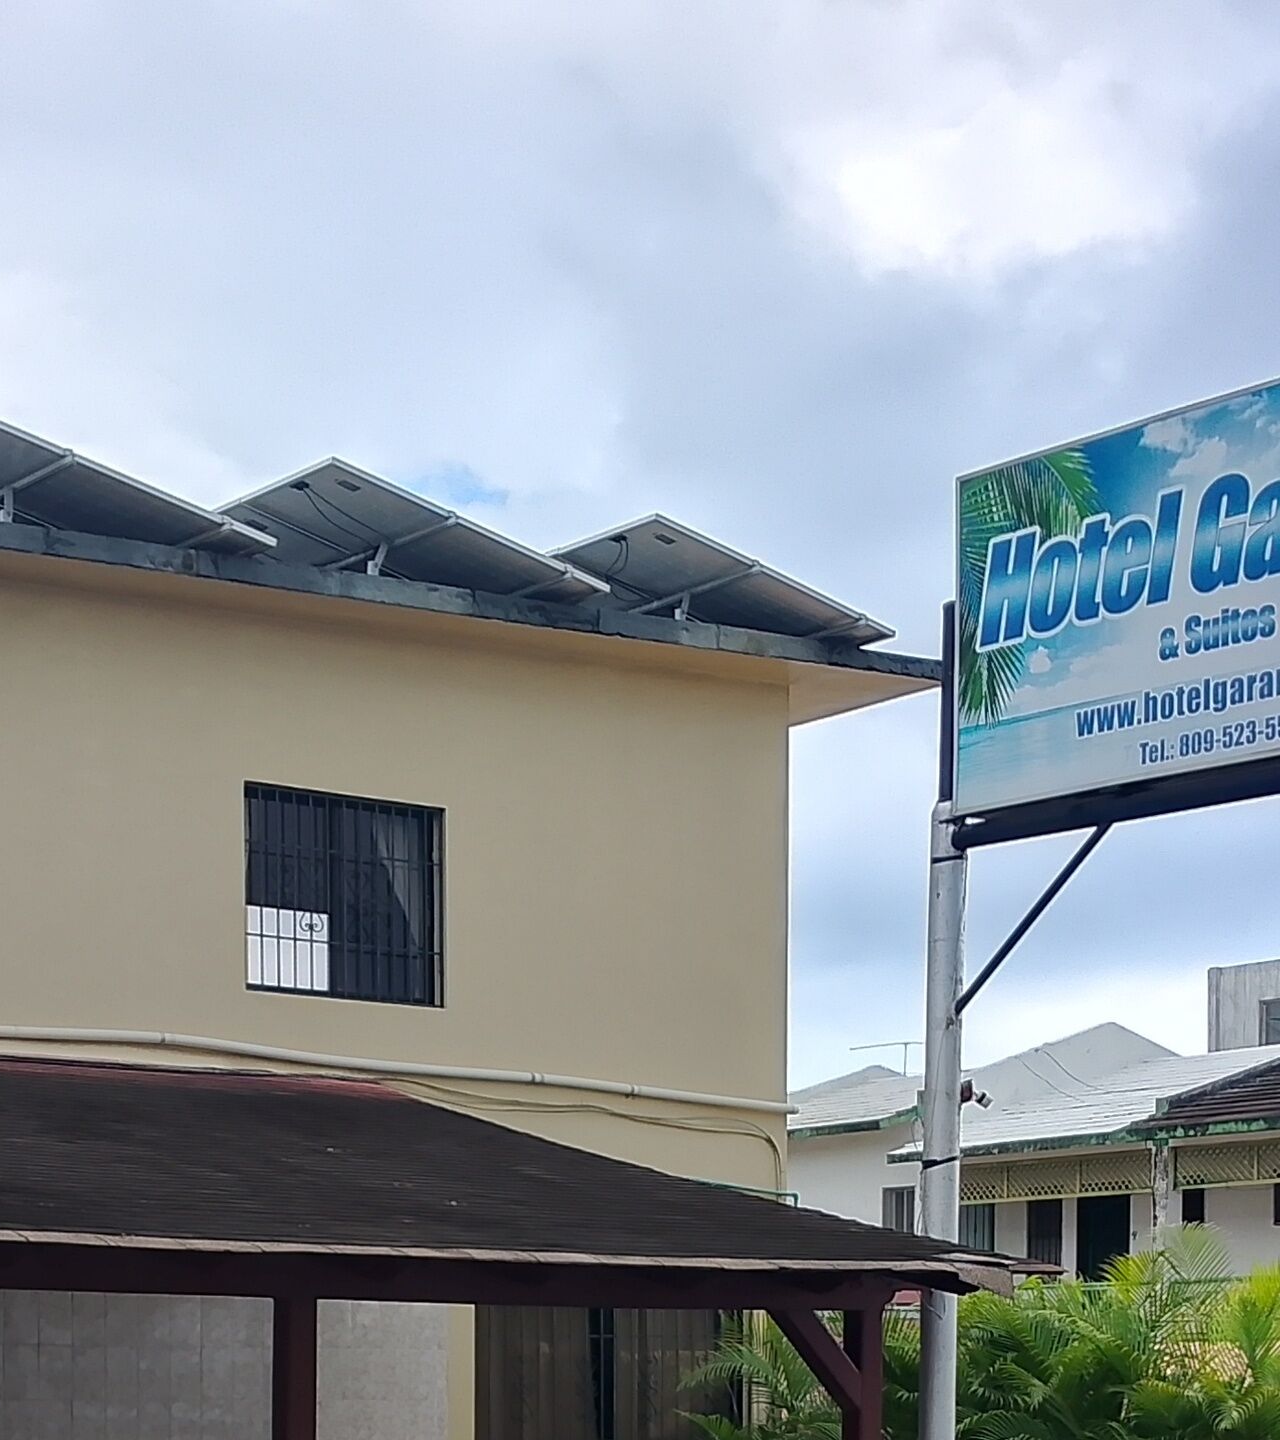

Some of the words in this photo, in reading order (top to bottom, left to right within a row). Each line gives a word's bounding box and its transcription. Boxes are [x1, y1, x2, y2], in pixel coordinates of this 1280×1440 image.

[978, 487, 1185, 649] Hotel
[1158, 627, 1180, 661] &
[1184, 604, 1277, 655] Suites
[1139, 741, 1175, 765] Tel.:
